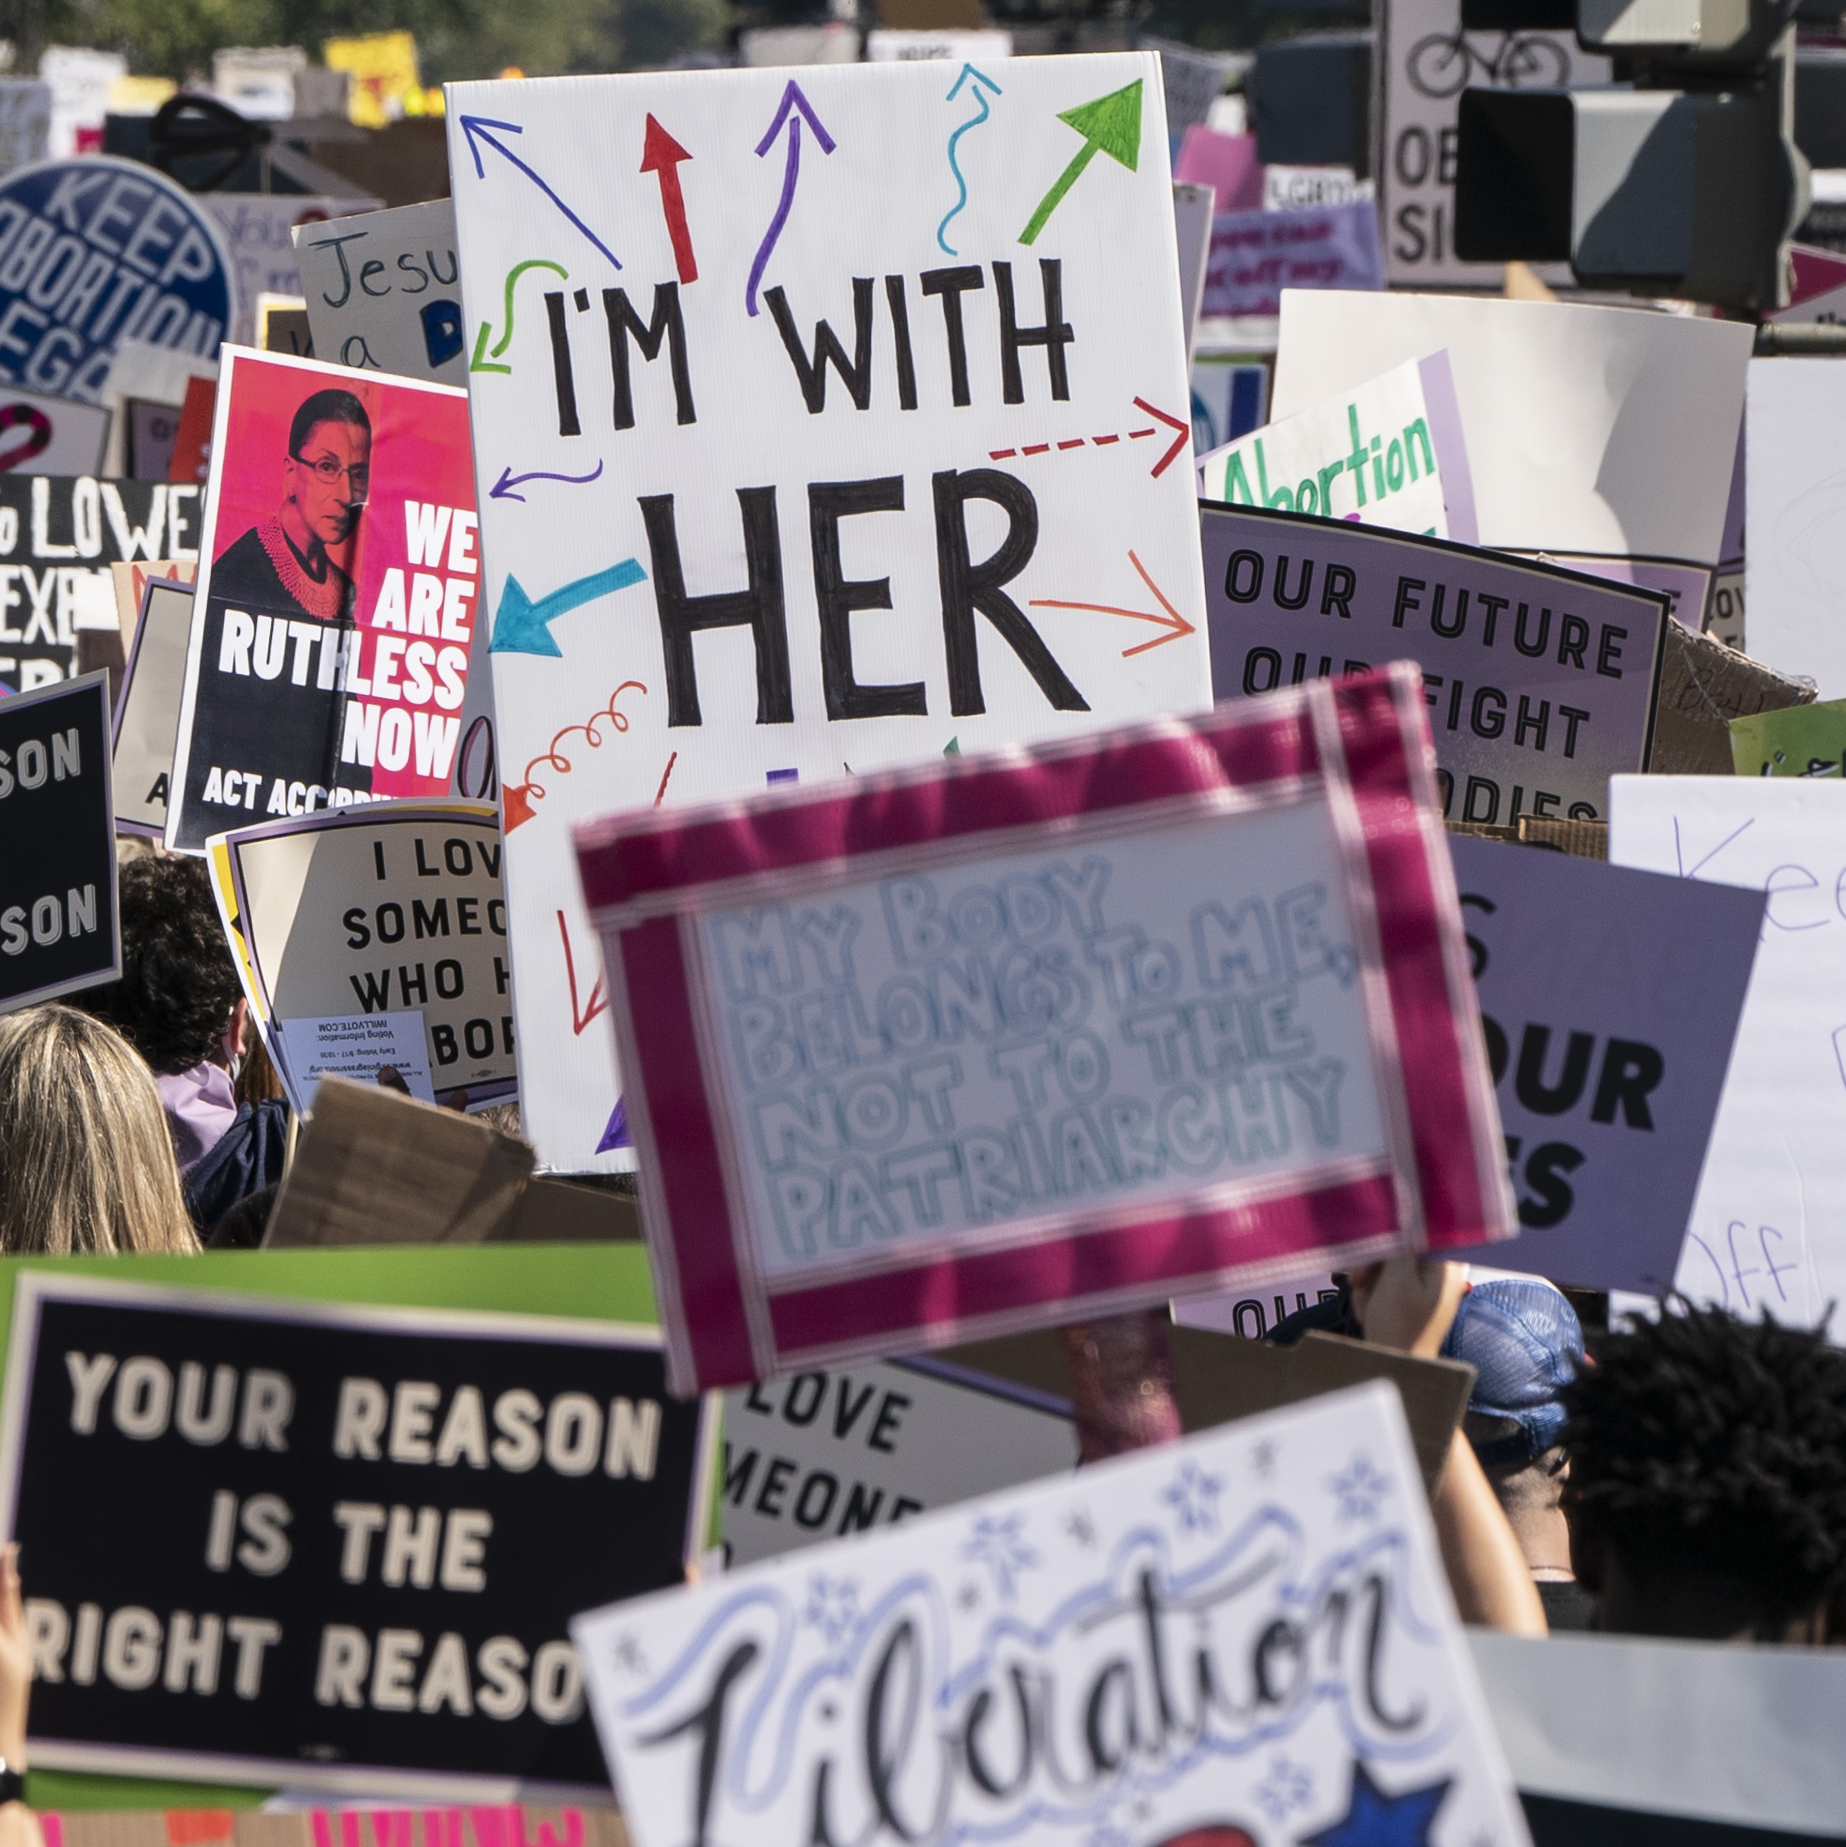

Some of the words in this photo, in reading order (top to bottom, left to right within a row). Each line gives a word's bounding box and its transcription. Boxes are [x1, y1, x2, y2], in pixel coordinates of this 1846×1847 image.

[44, 172, 214, 284] KEEP
[544, 278, 697, 437] I'M
[763, 257, 1075, 414] WITH
[1222, 403, 1436, 520] Abortion
[404, 500, 479, 569] WE
[371, 568, 476, 643] ARE
[637, 468, 1092, 728] HER
[1224, 548, 1358, 620] OUR
[1393, 576, 1629, 682] FUTURE
[202, 766, 264, 811] ACT
[340, 697, 461, 780] NOW
[372, 839, 388, 881] I
[348, 957, 466, 1013] WHO
[709, 899, 864, 999] MY
[726, 945, 1089, 1092] BELONGS
[752, 1057, 962, 1173] NOT
[987, 1024, 1112, 1119] TO
[1118, 983, 1316, 1082] THE
[766, 1054, 1347, 1260] PATRIARCHY
[65, 1352, 297, 1454] YOUR
[332, 1376, 663, 1482] REASON
[743, 1369, 916, 1455] LOVE
[203, 1490, 296, 1575] IS
[333, 1500, 495, 1594] THE
[23, 1597, 283, 1701] RIGHT
[313, 1624, 587, 1728] REASO
[633, 1552, 1429, 1847] Liberation
